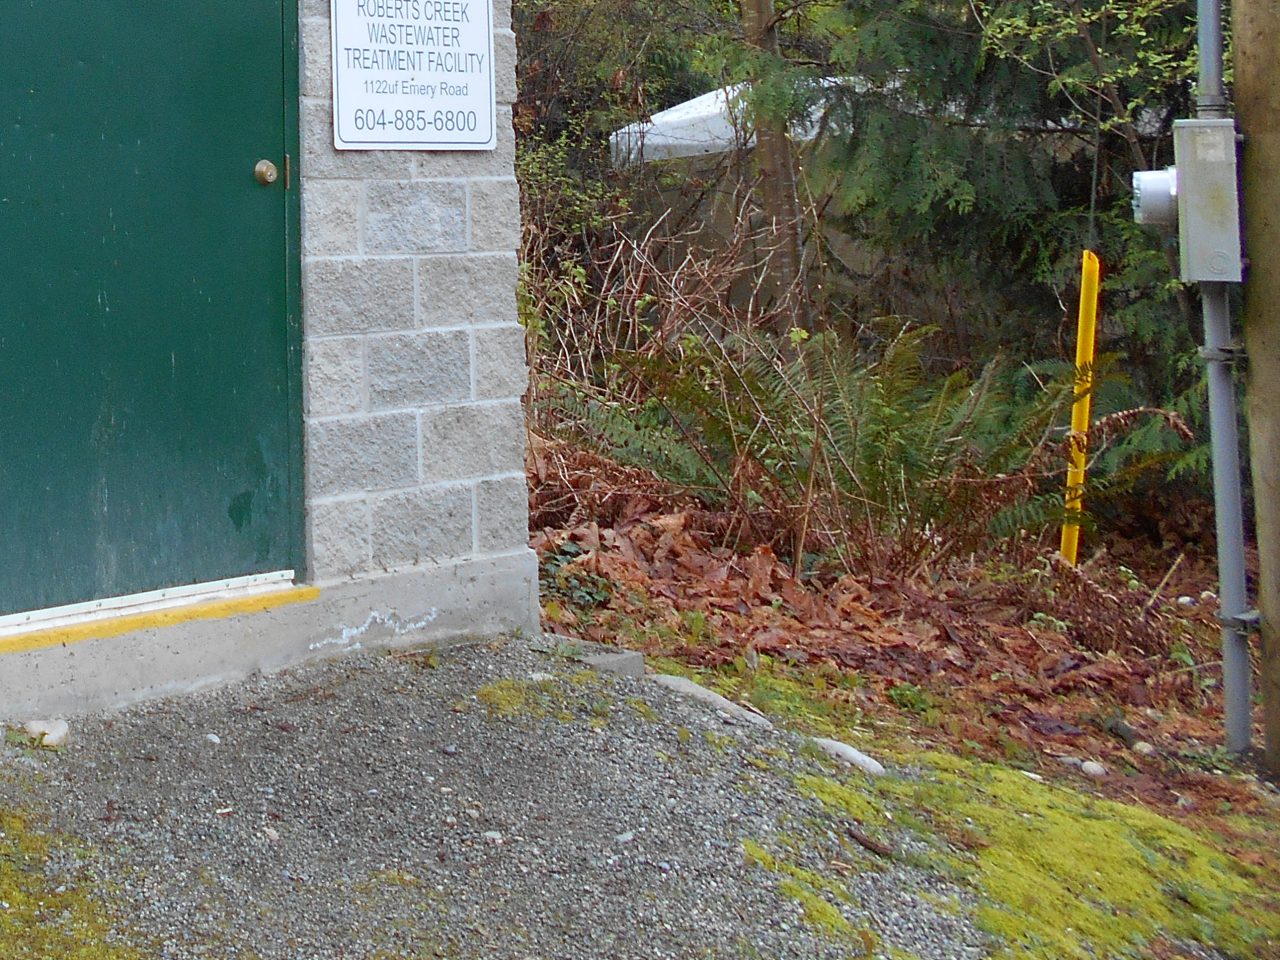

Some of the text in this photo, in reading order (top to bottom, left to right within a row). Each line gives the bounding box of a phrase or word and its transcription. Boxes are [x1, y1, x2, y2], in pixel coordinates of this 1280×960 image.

[424, 0, 470, 23] CREEK
[366, 22, 461, 47] WASTEWATER
[343, 47, 485, 73] TREATMENT FACILITY
[363, 79, 469, 100] 1122uf Emery Road
[354, 108, 477, 132] 604-885-6800
